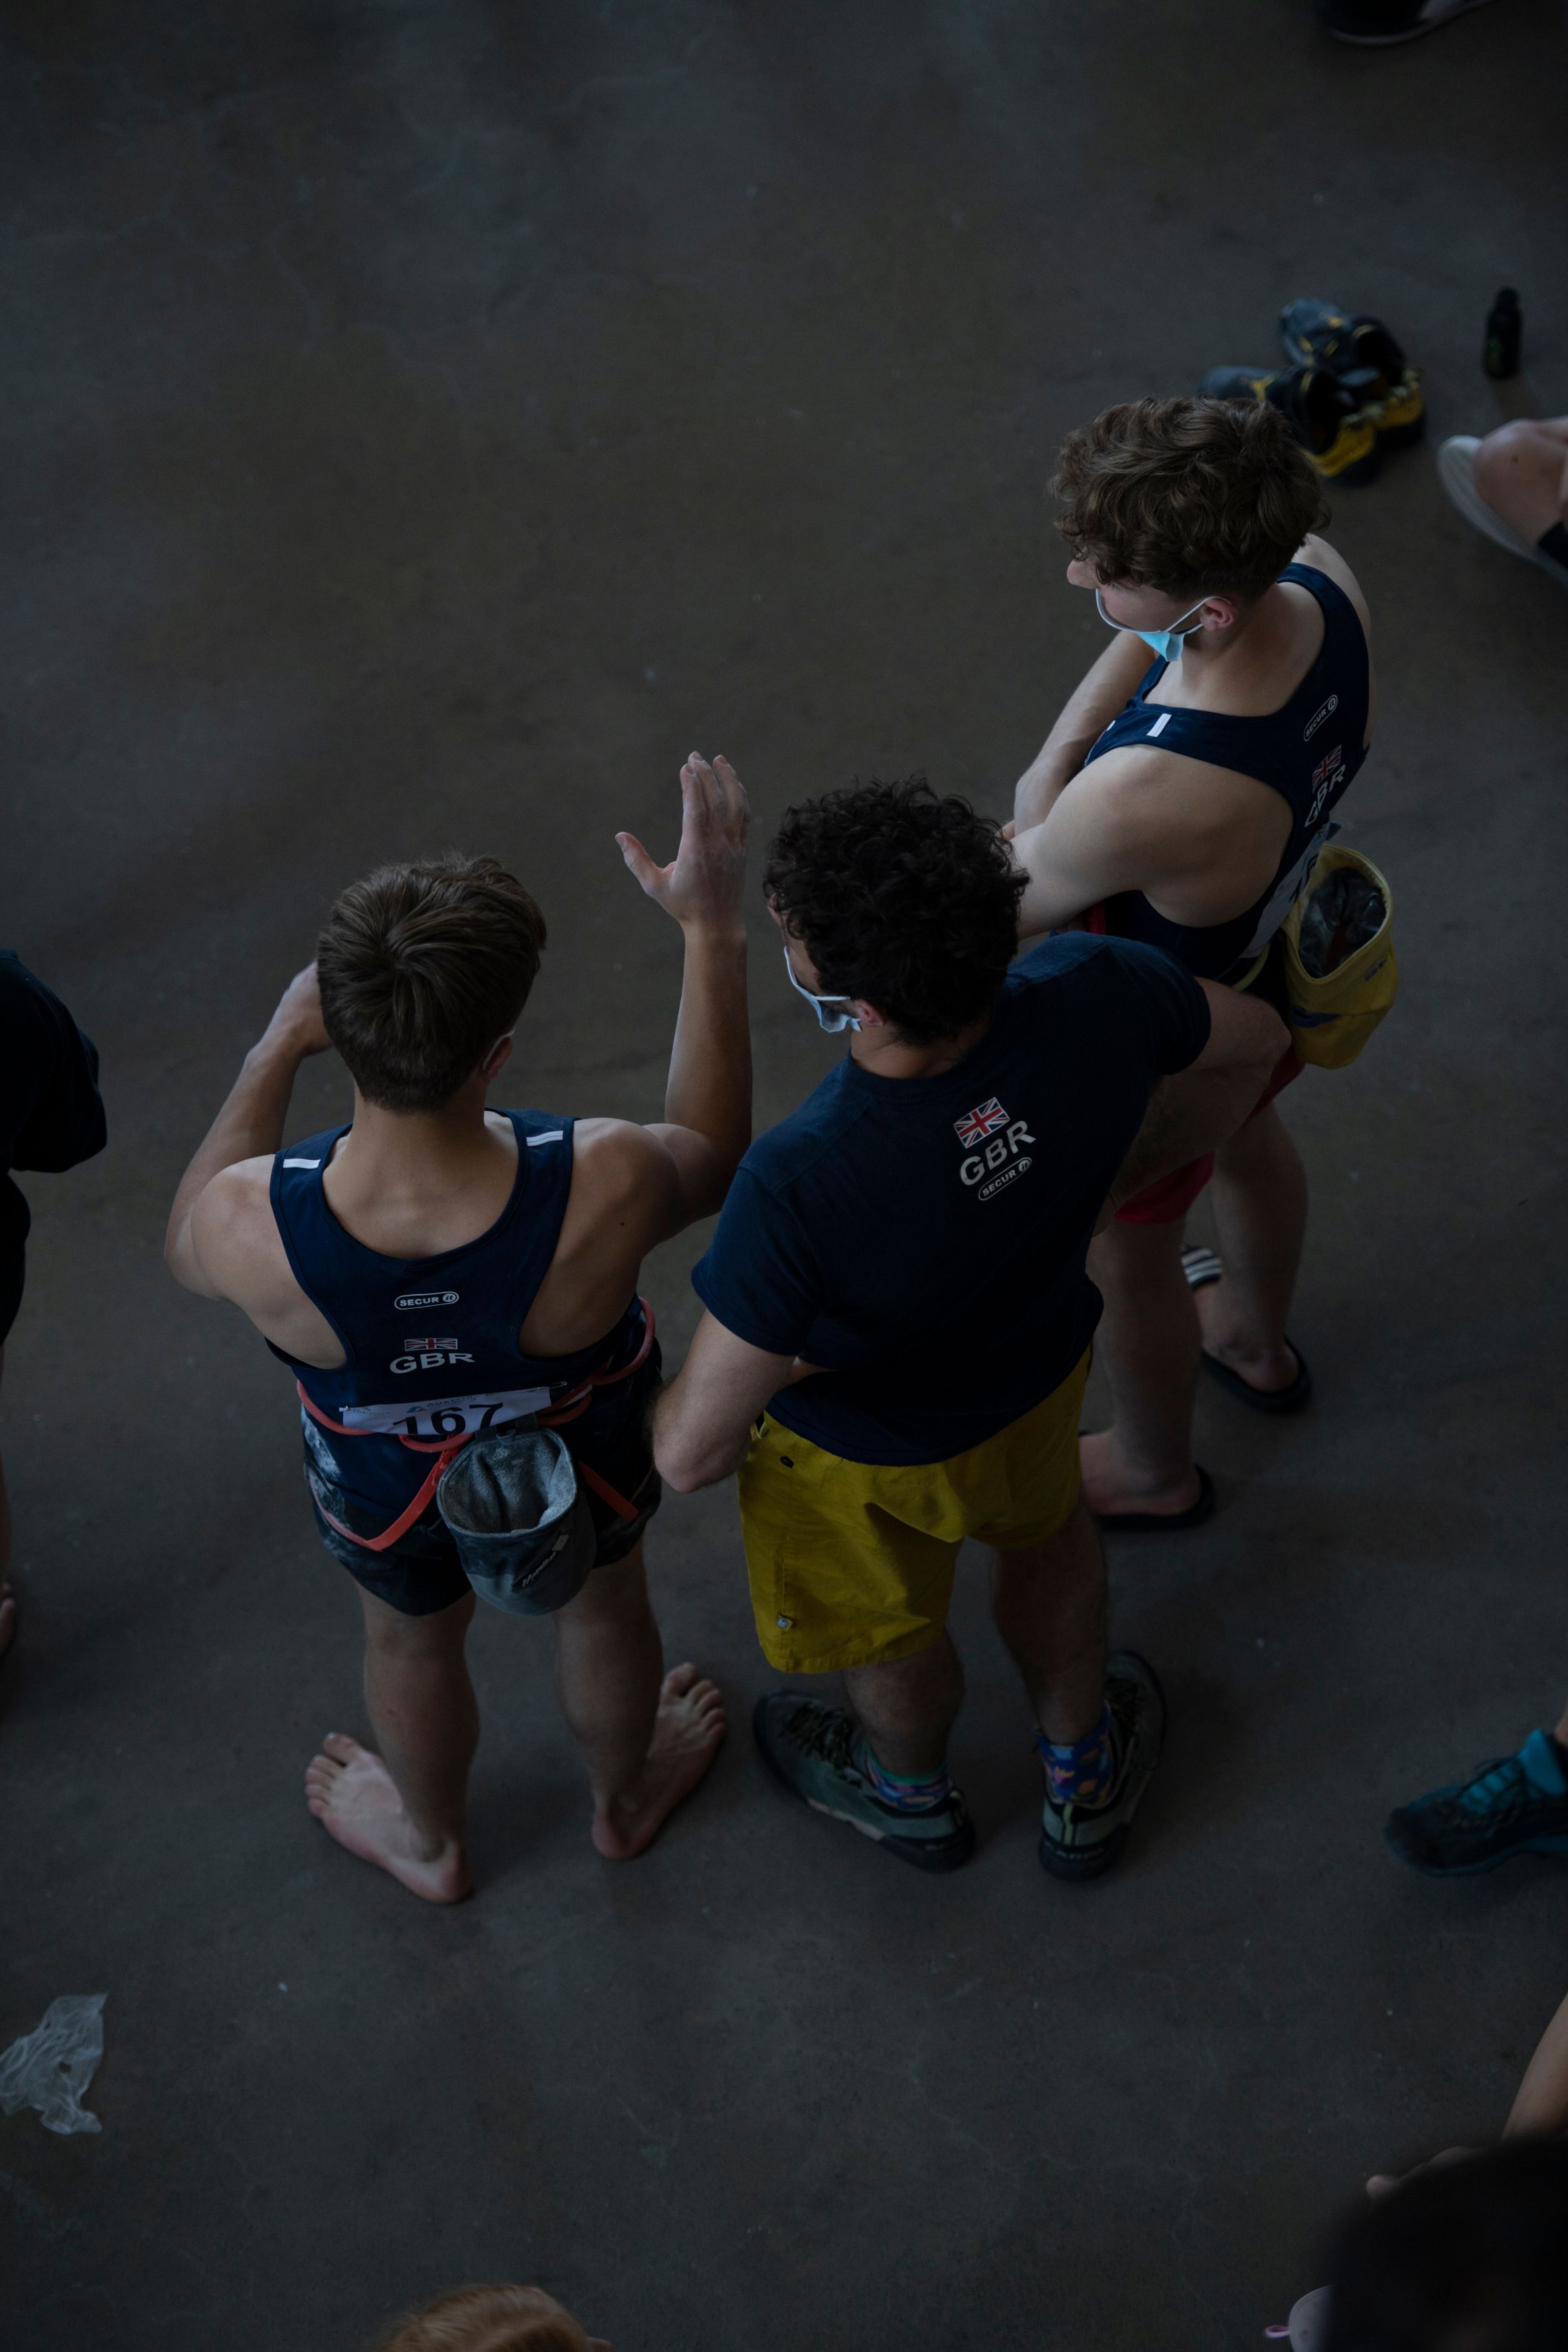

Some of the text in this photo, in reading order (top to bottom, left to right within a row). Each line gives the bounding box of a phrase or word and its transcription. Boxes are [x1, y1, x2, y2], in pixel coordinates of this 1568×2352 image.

[1305, 708, 1327, 738] SECUR
[1304, 764, 1346, 828] GBR
[959, 1120, 1037, 1186] GBR
[982, 1169, 1017, 1196] SECUR
[399, 1296, 439, 1306] SECUR
[390, 1352, 476, 1374] GBR
[392, 1402, 503, 1435] 167
